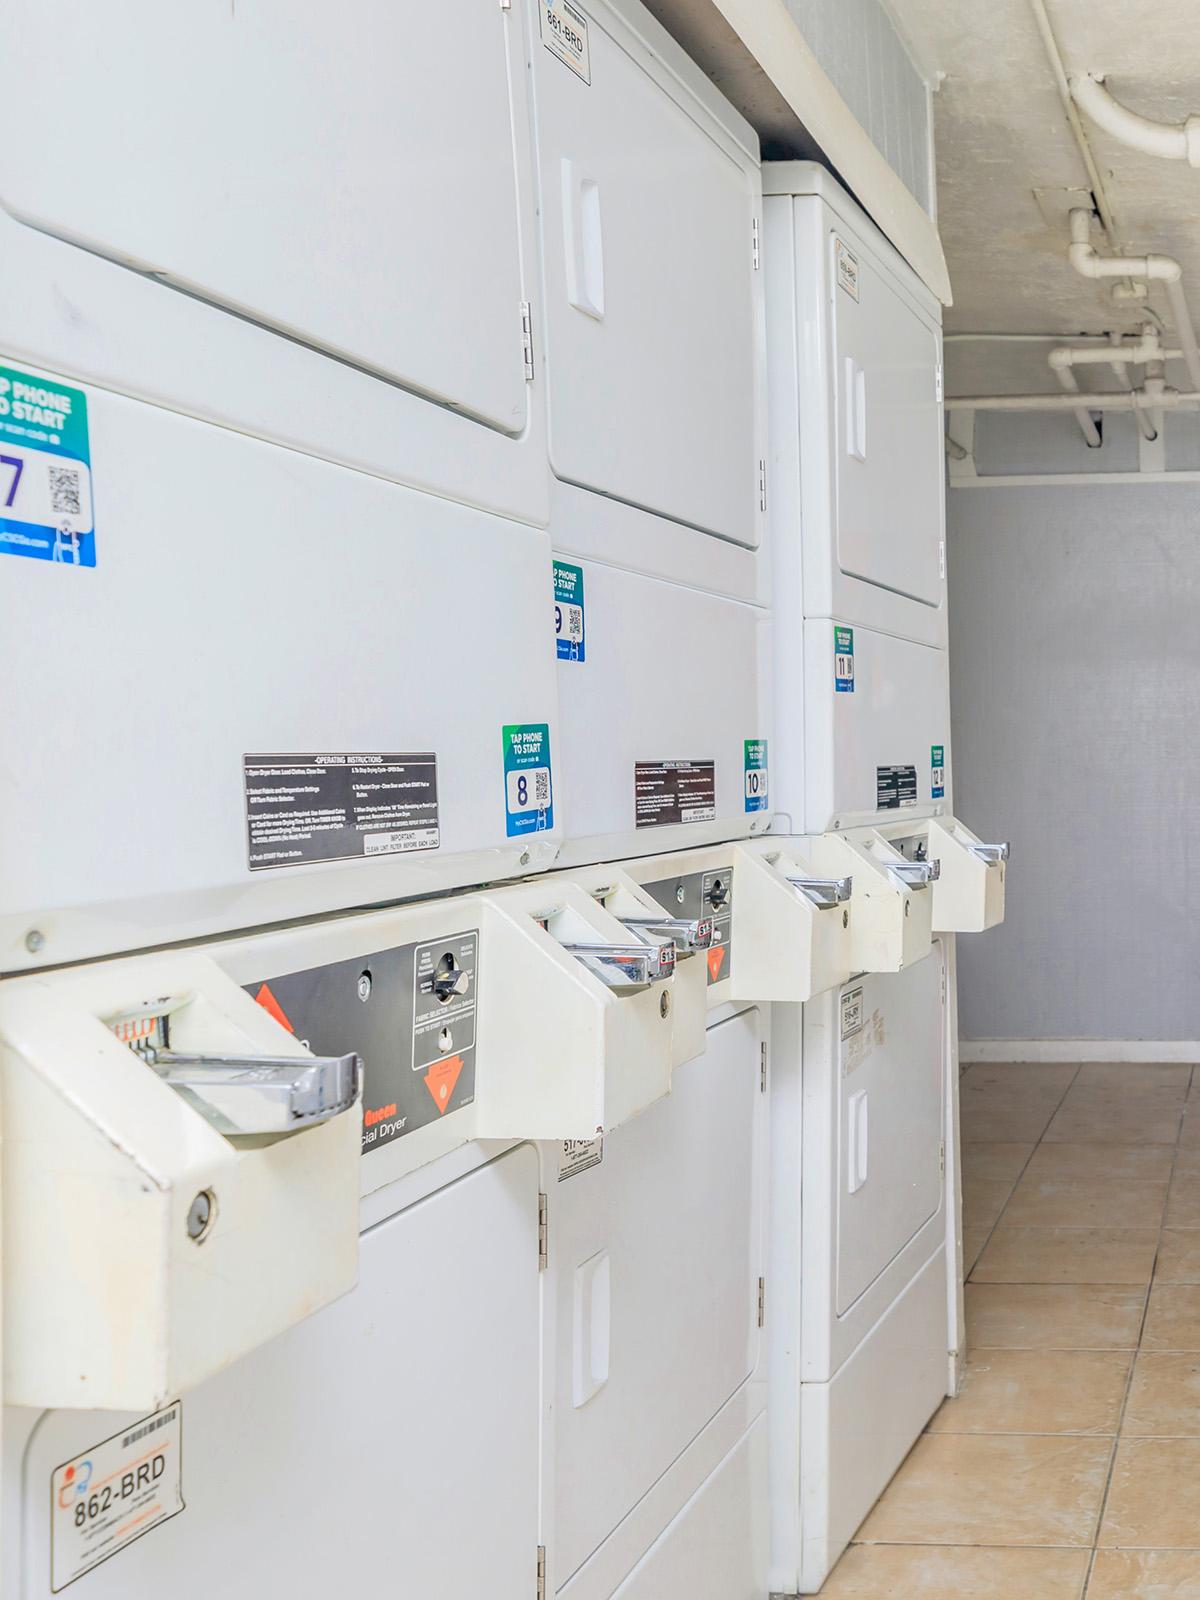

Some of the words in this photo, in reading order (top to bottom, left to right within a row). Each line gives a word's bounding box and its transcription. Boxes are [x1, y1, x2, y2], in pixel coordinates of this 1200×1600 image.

[547, 9, 583, 52] 861-BRD
[0, 396, 10, 415] O
[12, 400, 66, 430] START
[12, 381, 72, 414] PHONE
[0, 454, 24, 507] 7
[510, 734, 522, 743] TAP
[523, 732, 543, 743] PHONE
[513, 744, 522, 754] TO
[523, 743, 541, 754] START
[517, 775, 528, 806] 8
[748, 773, 759, 793] 10
[364, 1103, 398, 1127] Queen
[361, 1129, 378, 1146] cial
[380, 1116, 408, 1137] Dryer
[75, 1454, 166, 1527] 862-BRD
